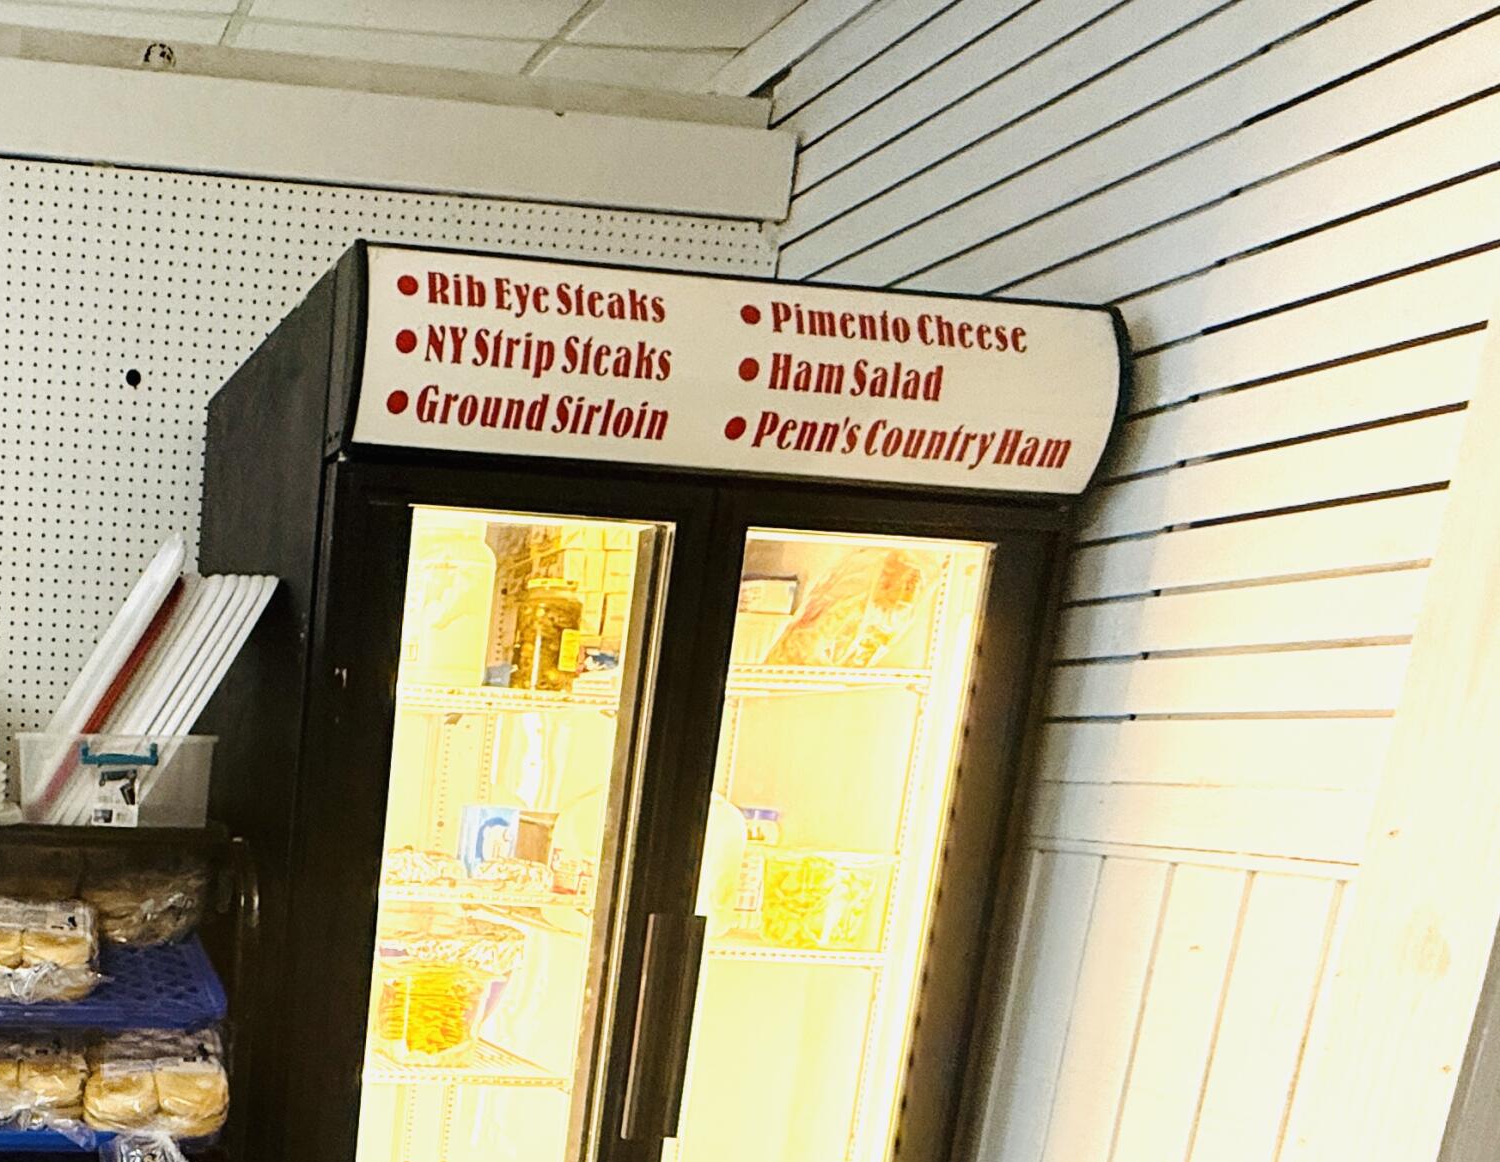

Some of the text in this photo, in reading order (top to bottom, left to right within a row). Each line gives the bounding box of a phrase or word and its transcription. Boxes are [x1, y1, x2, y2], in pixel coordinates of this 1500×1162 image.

[427, 271, 667, 323] Rib Eye Steaks
[424, 324, 672, 381] NY Strip Steaks
[771, 301, 1028, 353] Pimento Cheese
[768, 352, 945, 401] Ham Salad
[415, 384, 670, 441] Ground Sirloin
[751, 410, 1073, 470] Penn's Country Ham
